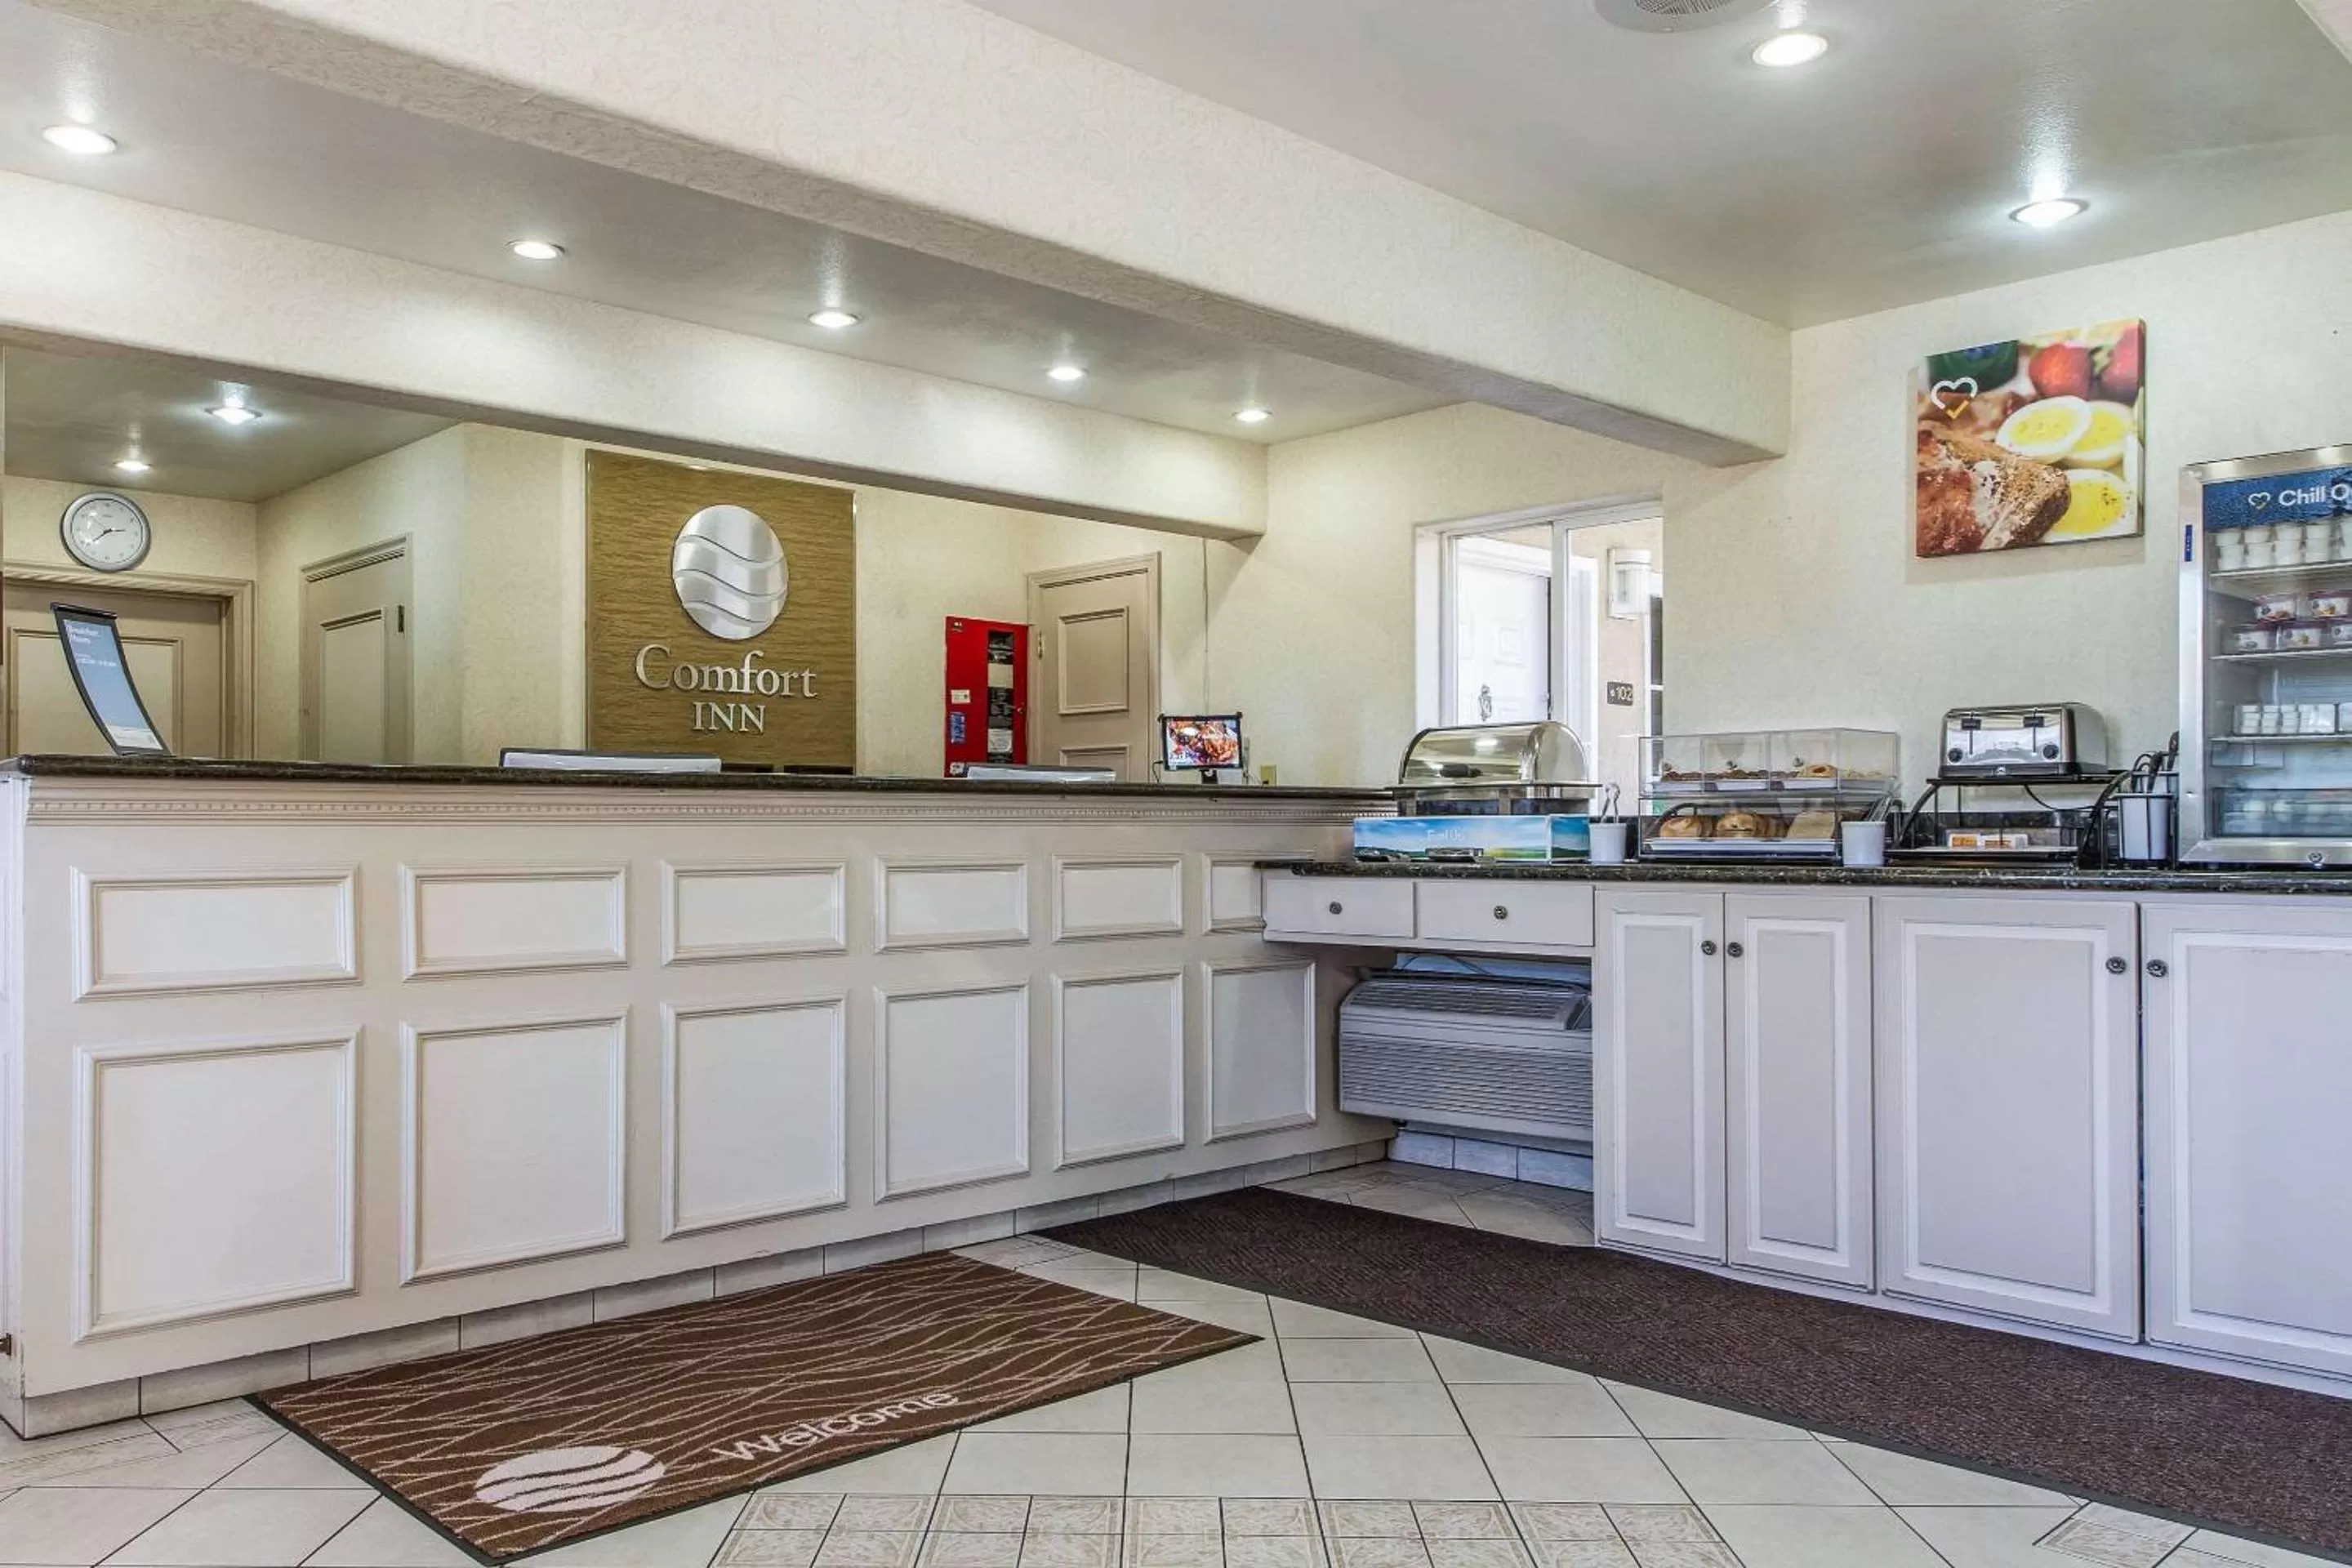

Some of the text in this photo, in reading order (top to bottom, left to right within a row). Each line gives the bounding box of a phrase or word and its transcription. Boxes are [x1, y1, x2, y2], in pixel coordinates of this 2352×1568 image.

[2278, 485, 2327, 506] Chill
[635, 643, 818, 697] Comfort
[1616, 686, 1633, 701] 102
[692, 702, 766, 733] INN
[710, 1392, 959, 1461] Welcome
